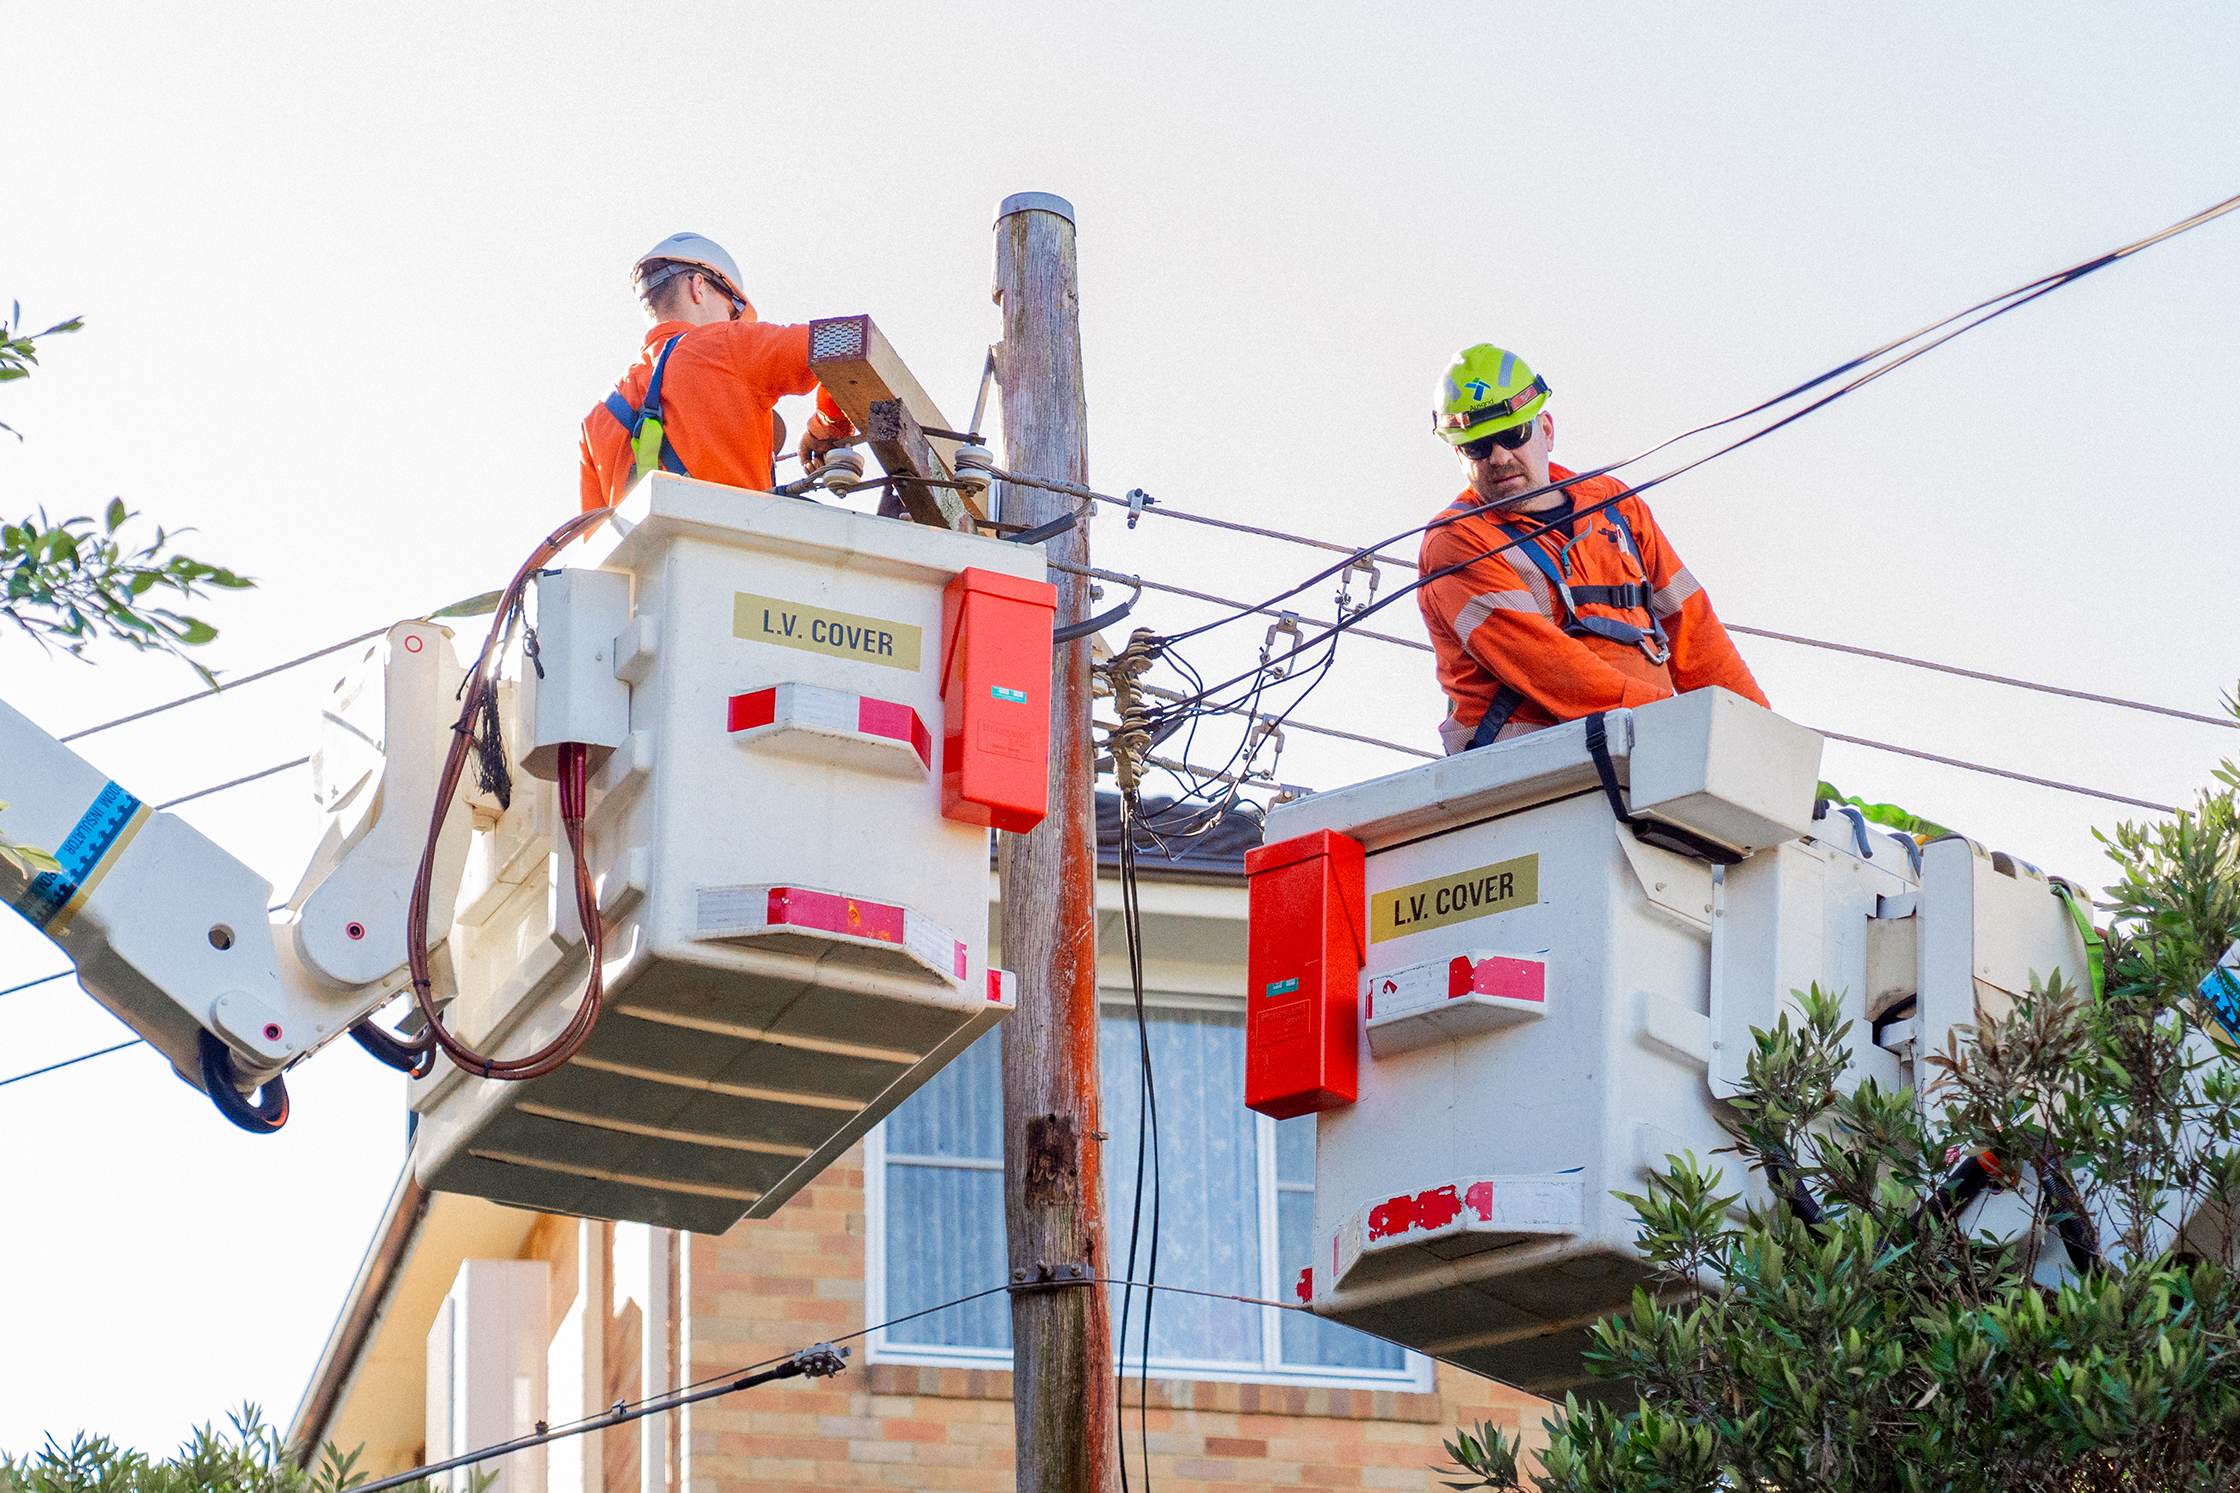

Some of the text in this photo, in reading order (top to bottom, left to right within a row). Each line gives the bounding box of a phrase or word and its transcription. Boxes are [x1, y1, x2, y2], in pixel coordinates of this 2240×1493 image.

[763, 609, 893, 656] L.V. COVER
[63, 805, 105, 855] INSULATOR
[1394, 872, 1513, 926] L.V. COVER
